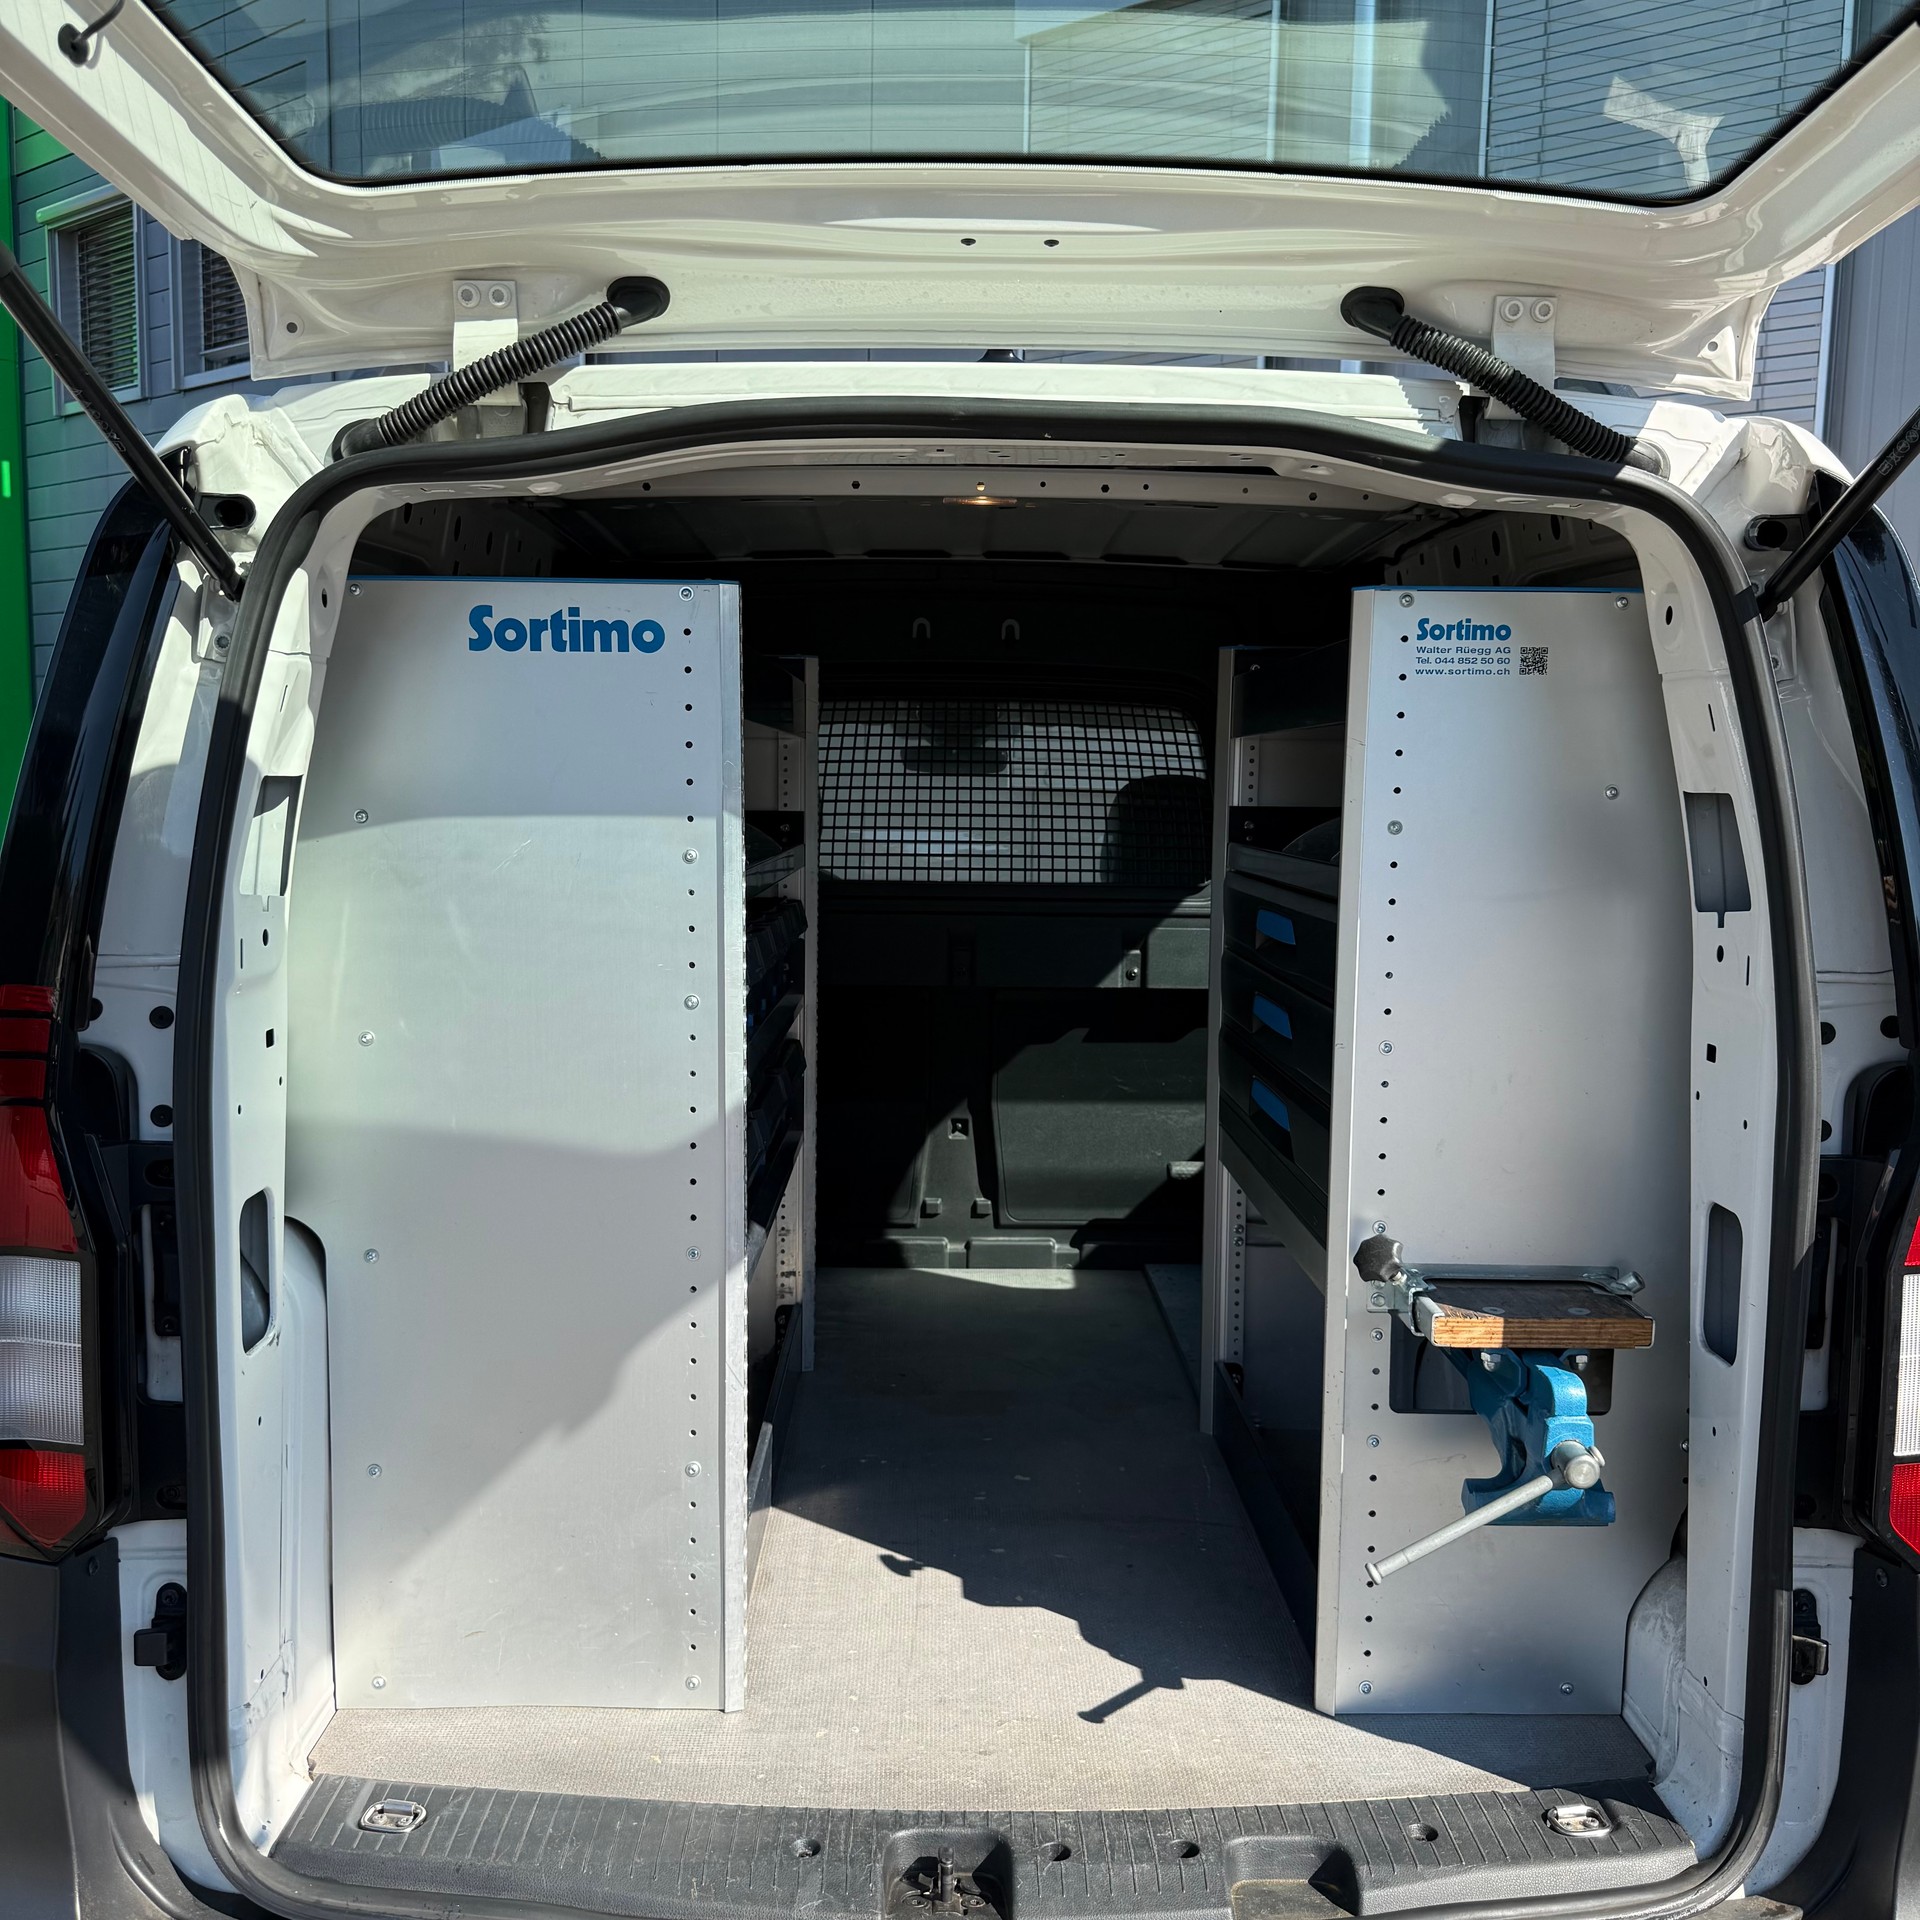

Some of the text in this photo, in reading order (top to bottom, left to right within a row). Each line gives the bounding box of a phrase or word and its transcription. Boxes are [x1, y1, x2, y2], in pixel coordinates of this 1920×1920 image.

[468, 604, 666, 654] Sortimo
[1416, 617, 1512, 641] Sortimo
[1416, 646, 1511, 656] Walter Rüegg AG
[1415, 656, 1511, 665] Tel. 044 852 50 60
[1415, 667, 1511, 676] www.sortimo.ch
